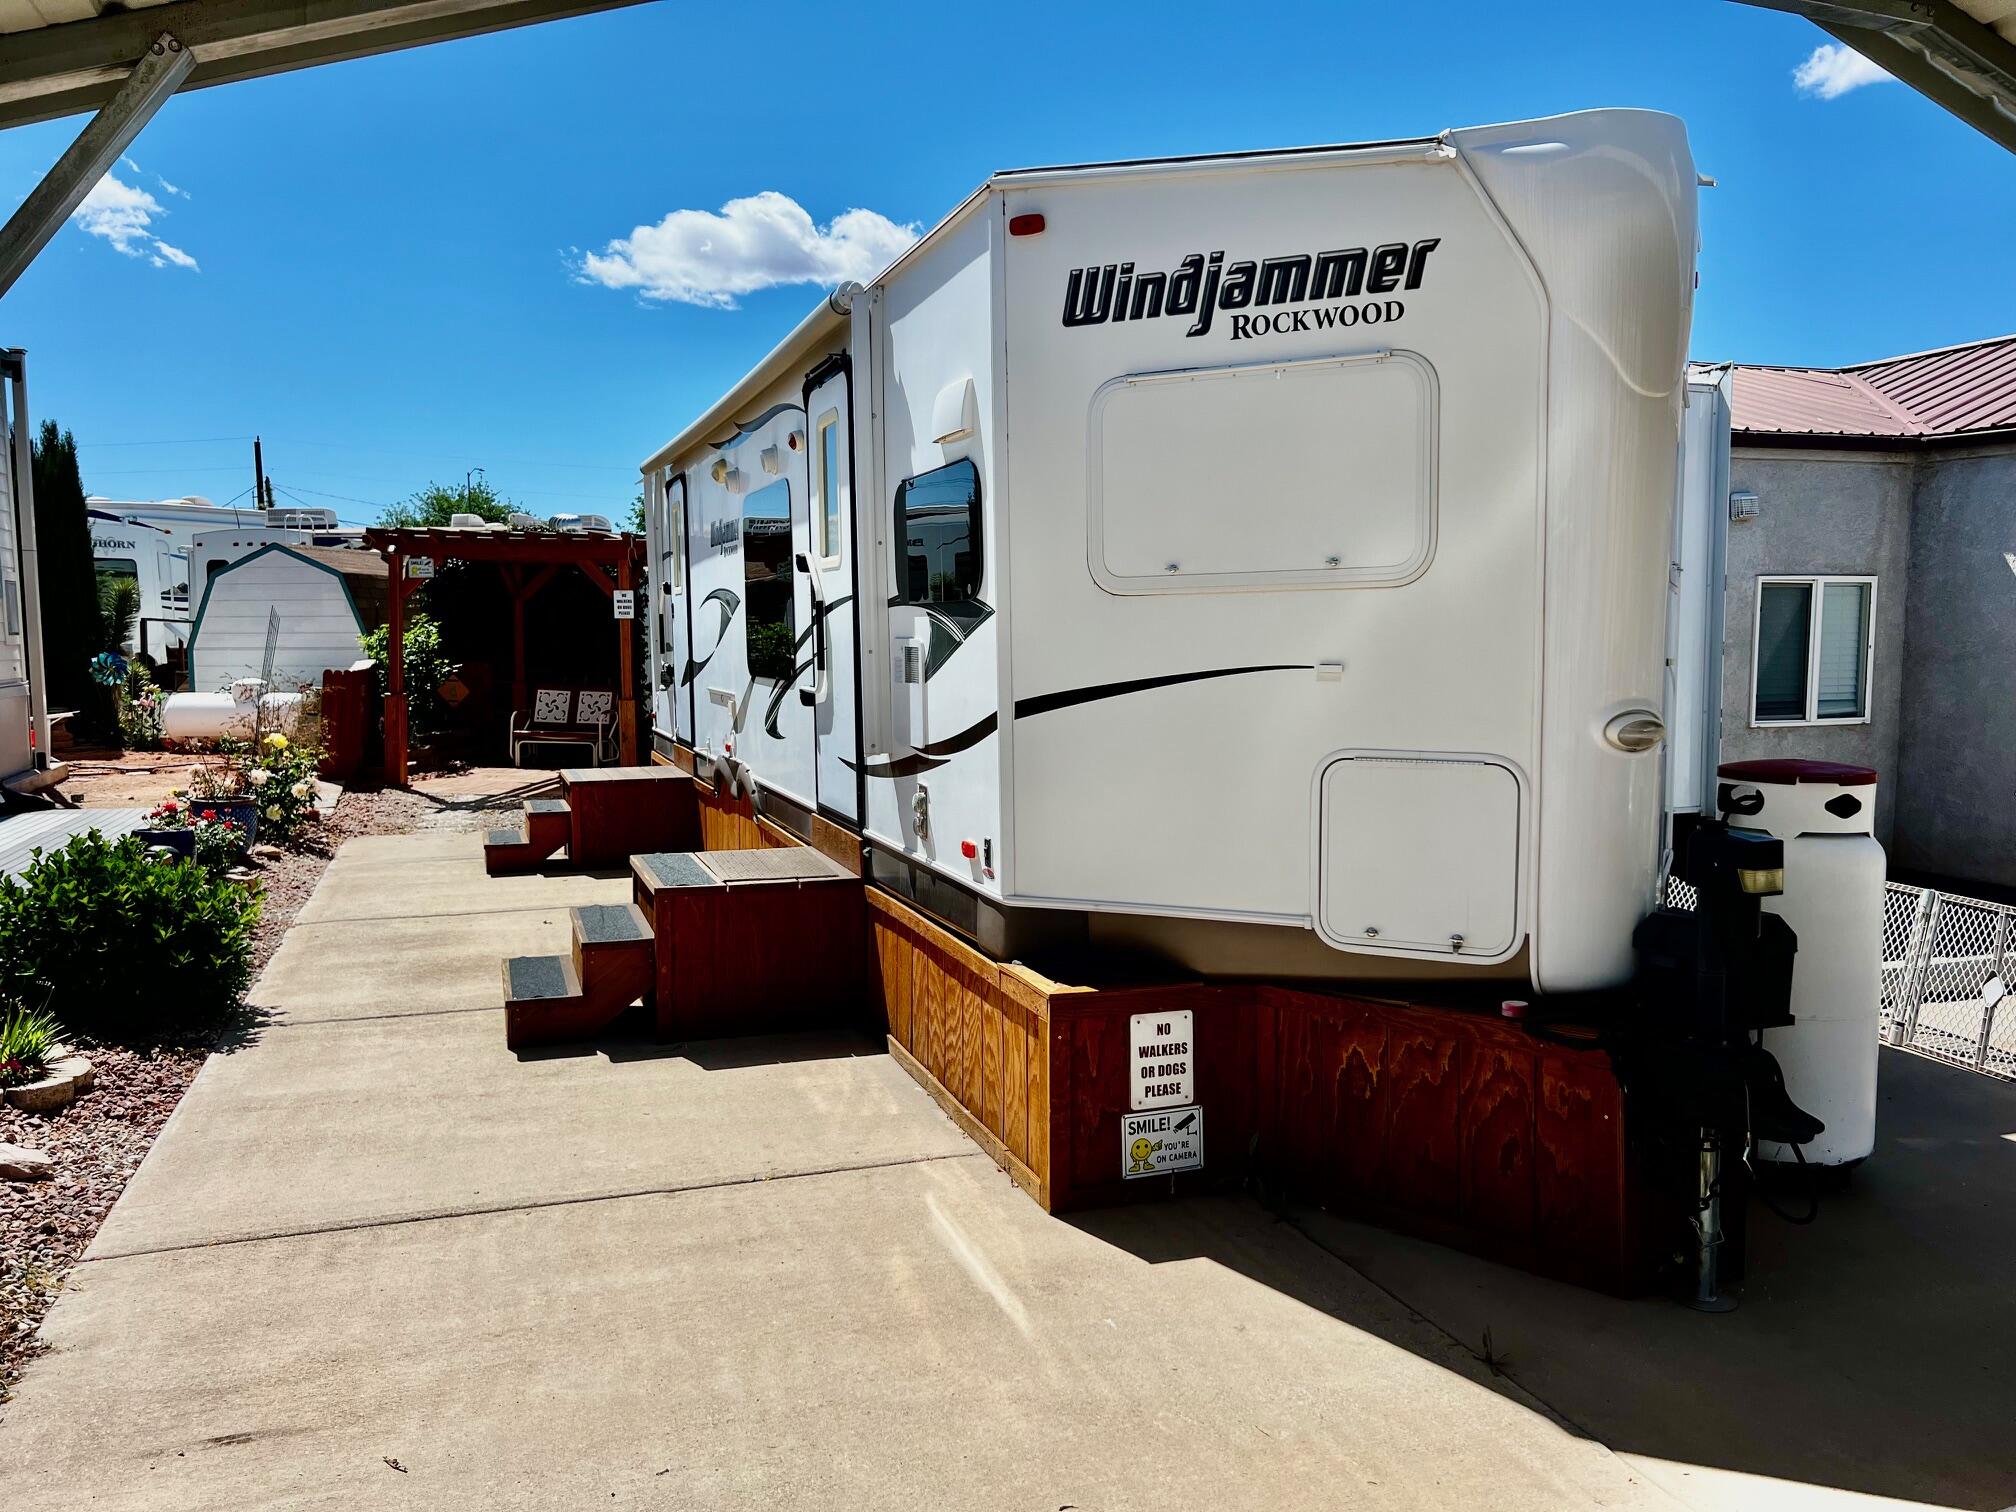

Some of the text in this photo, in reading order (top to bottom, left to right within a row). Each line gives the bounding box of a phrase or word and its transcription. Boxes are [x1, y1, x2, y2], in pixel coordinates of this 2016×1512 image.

[1062, 237, 1441, 338] Windjammer
[1230, 300, 1406, 342] ROCKWOOD
[1156, 1022, 1171, 1036] NO
[1138, 1042, 1188, 1059] WALKERS
[1140, 1062, 1187, 1079] OR DOGS
[1144, 1082, 1182, 1099] PLEASE
[1128, 1117, 1171, 1135] SMILE!
[1163, 1139, 1190, 1151] YOU'RE
[1156, 1148, 1198, 1164] ON CAMERA
